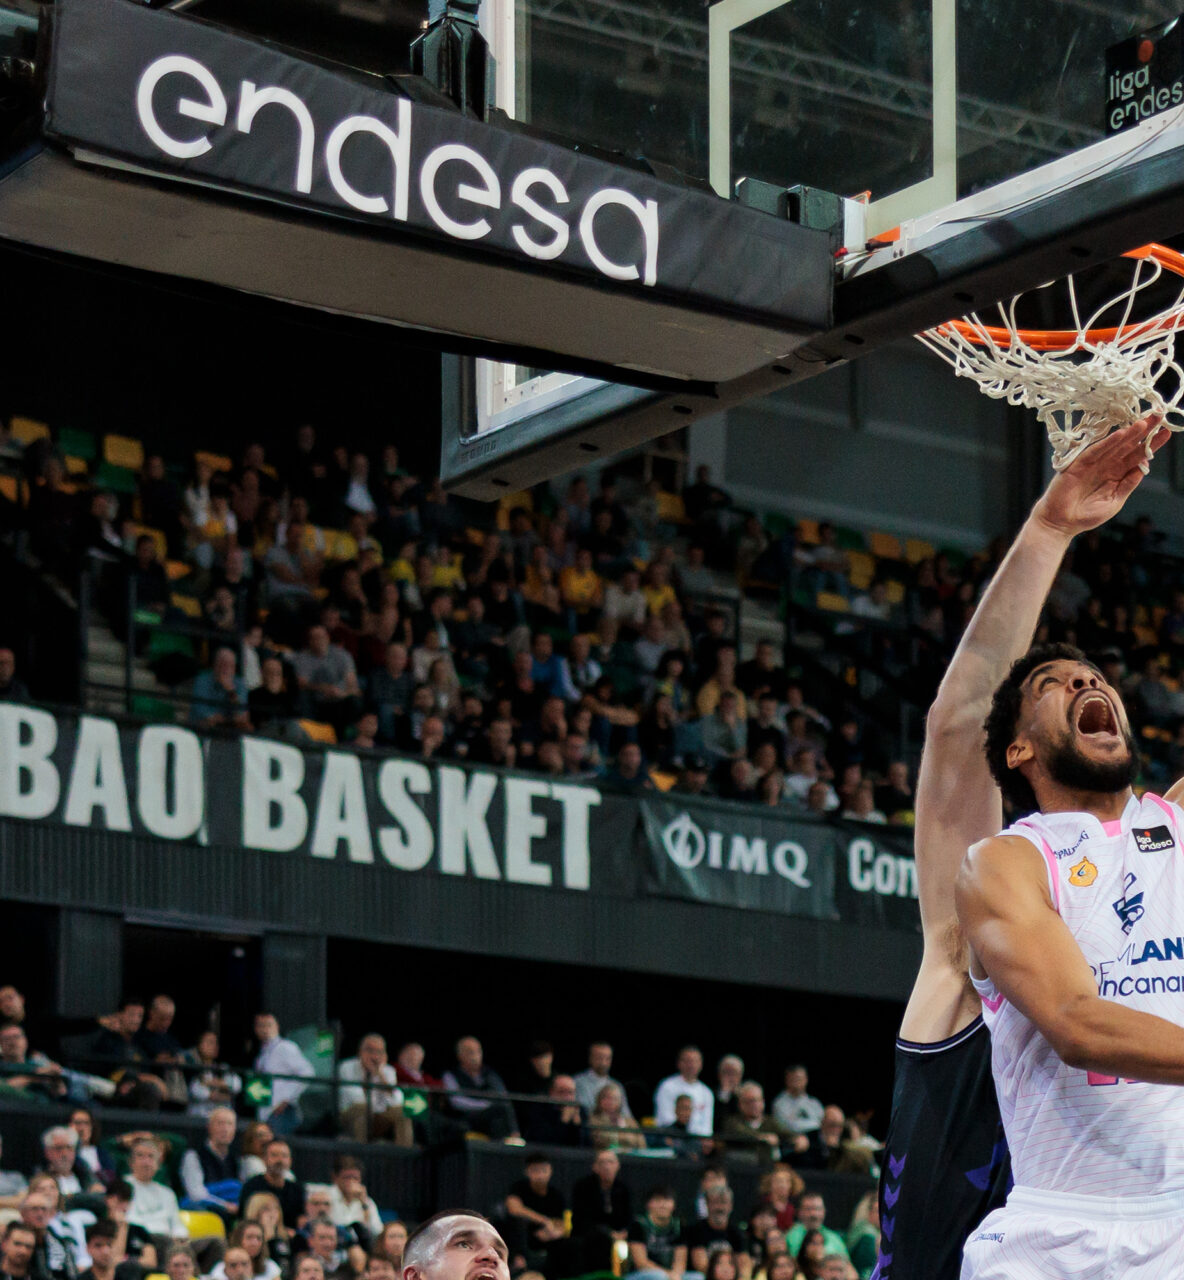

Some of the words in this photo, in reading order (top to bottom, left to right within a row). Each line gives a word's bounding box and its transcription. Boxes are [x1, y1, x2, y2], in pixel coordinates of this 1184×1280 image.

[1110, 65, 1150, 101] liga
[137, 55, 660, 287] endesa
[0, 704, 207, 844] BAO
[242, 735, 601, 890] BASKET
[708, 831, 812, 888] IMQ
